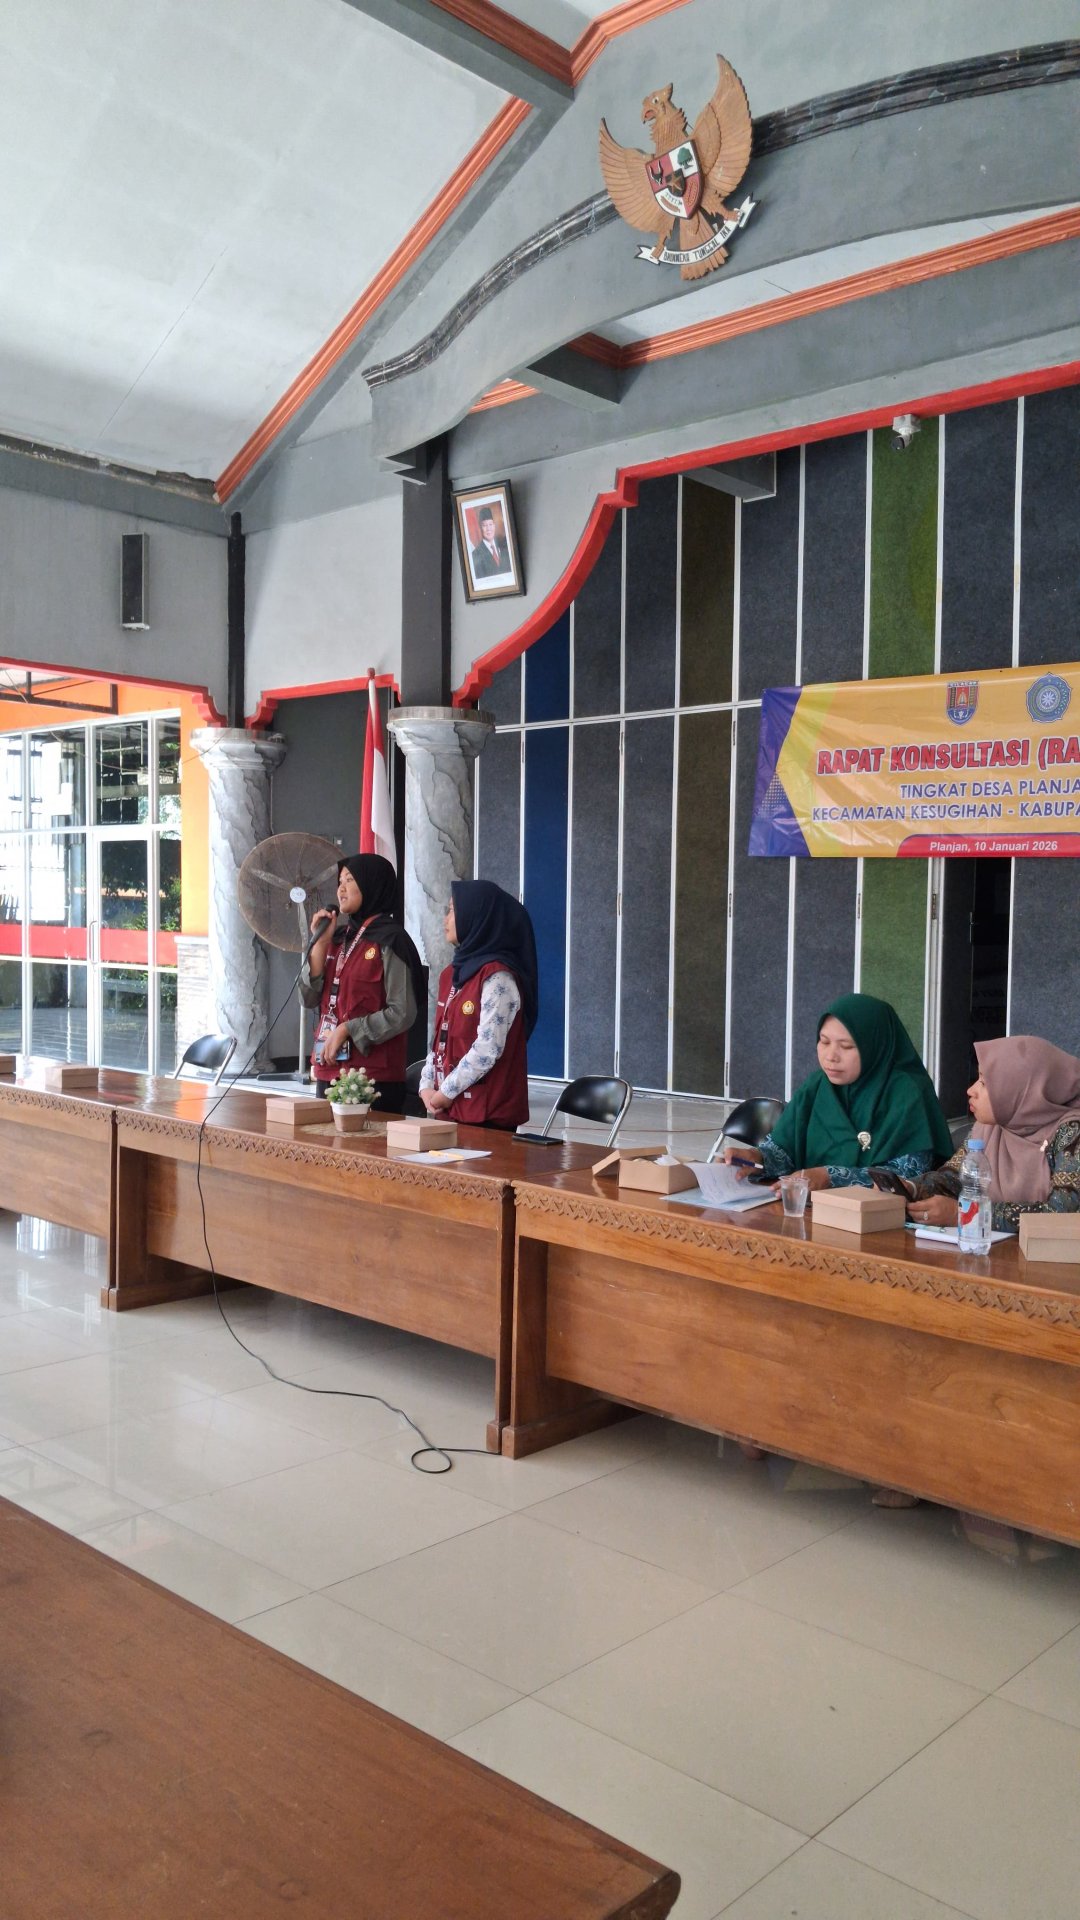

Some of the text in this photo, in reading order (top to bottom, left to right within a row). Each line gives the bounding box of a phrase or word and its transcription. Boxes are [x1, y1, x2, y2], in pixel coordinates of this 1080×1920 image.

[817, 748, 885, 774] RAPAT
[890, 739, 1030, 771] KONSULTASI
[900, 783, 966, 798] TINGKAT
[972, 781, 1013, 796] DESA
[813, 806, 906, 821] KECAMATAN
[911, 804, 1002, 819] KESUGIHAN
[930, 840, 1058, 852] Planjan, 10 Januari 2026
